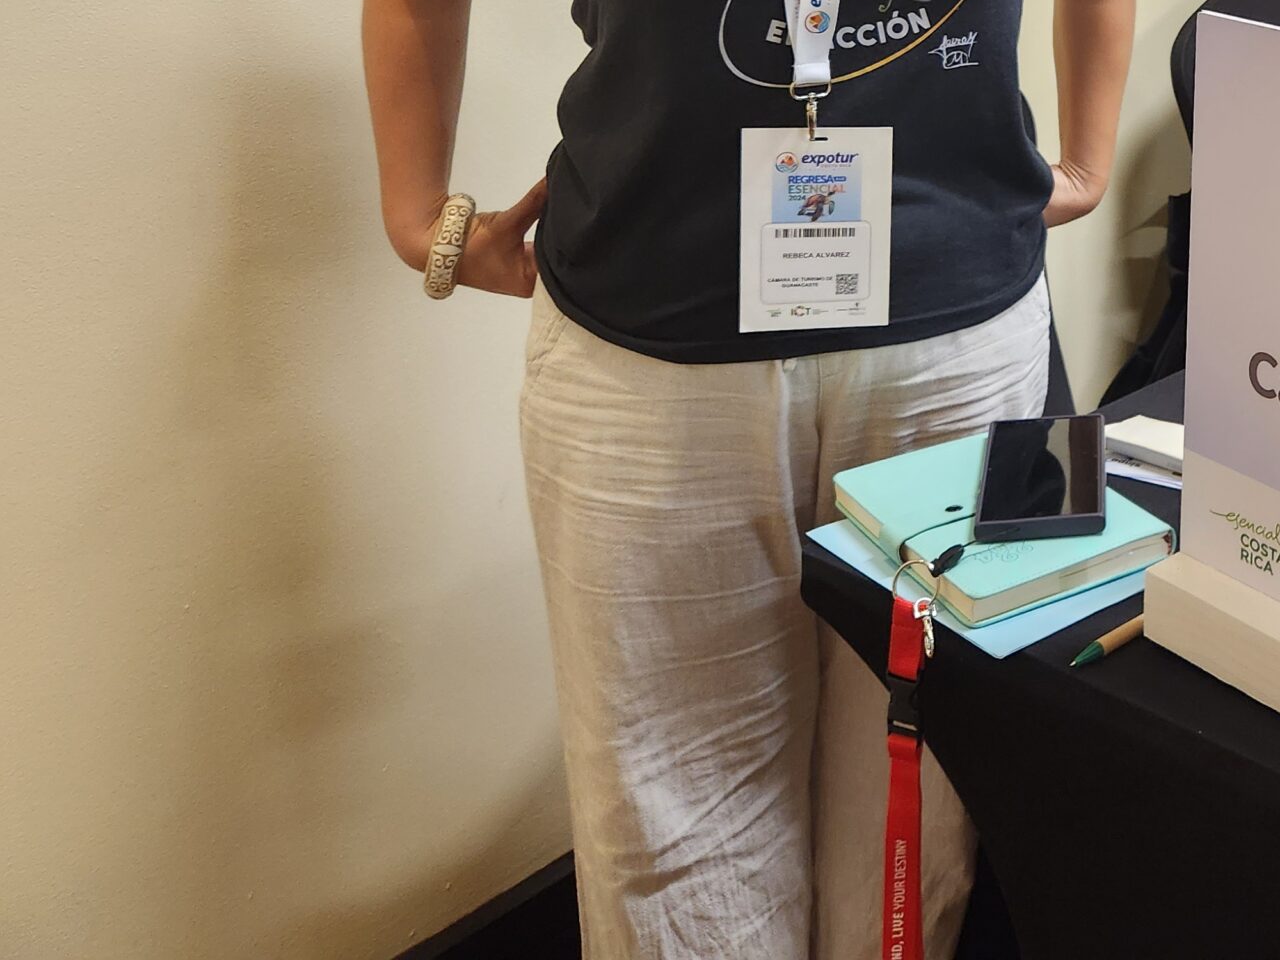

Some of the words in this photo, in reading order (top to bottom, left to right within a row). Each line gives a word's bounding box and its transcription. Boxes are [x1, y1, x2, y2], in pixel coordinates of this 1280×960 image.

[802, 152, 856, 167] expotur
[788, 175, 833, 184] REGRESA
[788, 185, 846, 194] ESENCIAL
[1240, 548, 1274, 576] RICA
[894, 839, 907, 879] DESTINY
[893, 880, 905, 910] YOUR
[892, 912, 904, 938] LIVE
